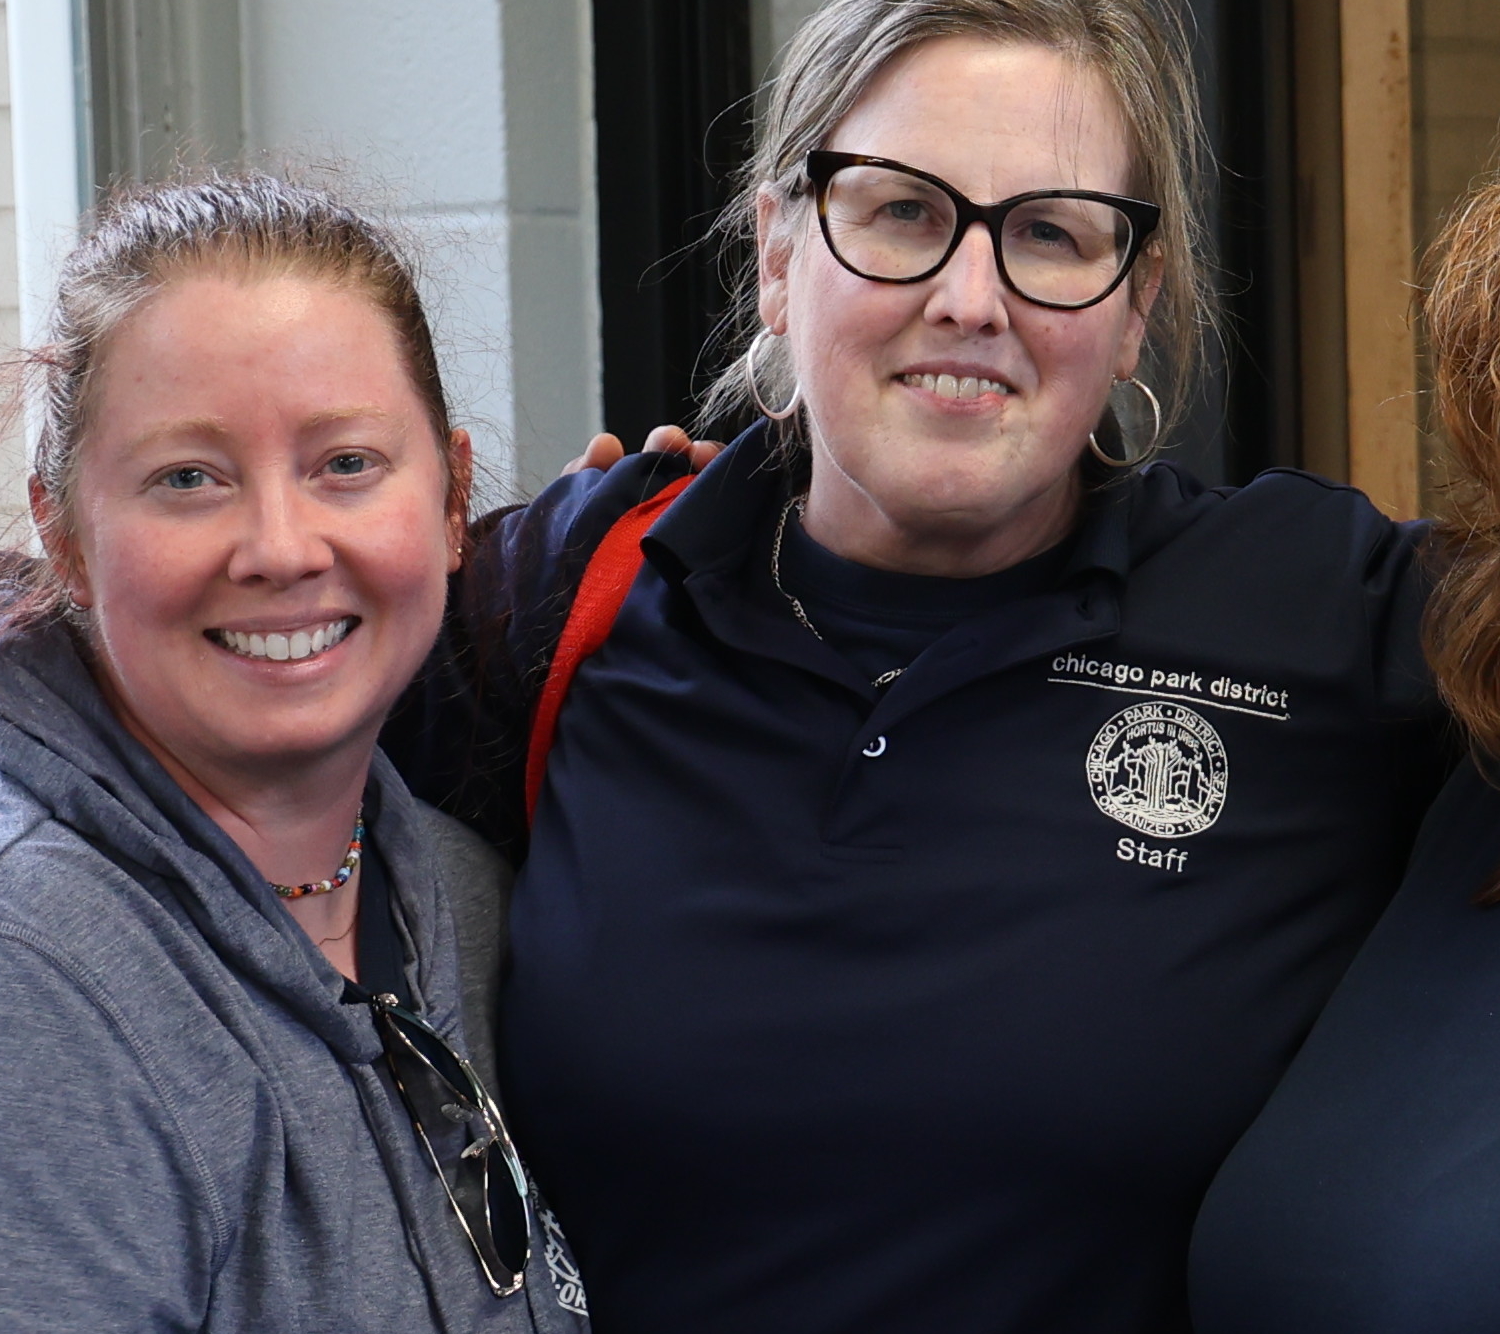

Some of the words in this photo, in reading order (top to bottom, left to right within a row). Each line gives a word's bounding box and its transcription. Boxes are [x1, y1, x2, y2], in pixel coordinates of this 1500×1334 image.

[1052, 652, 1144, 684] chicago
[1150, 667, 1202, 693] park
[1210, 677, 1289, 708] district
[1089, 719, 1118, 783] CHICAGO
[1123, 704, 1164, 725] PARK
[1174, 708, 1224, 760] DISTRICT
[1213, 770, 1226, 805] SEAL
[1099, 795, 1176, 835] ORGANIZED
[1116, 837, 1189, 873] Staff
